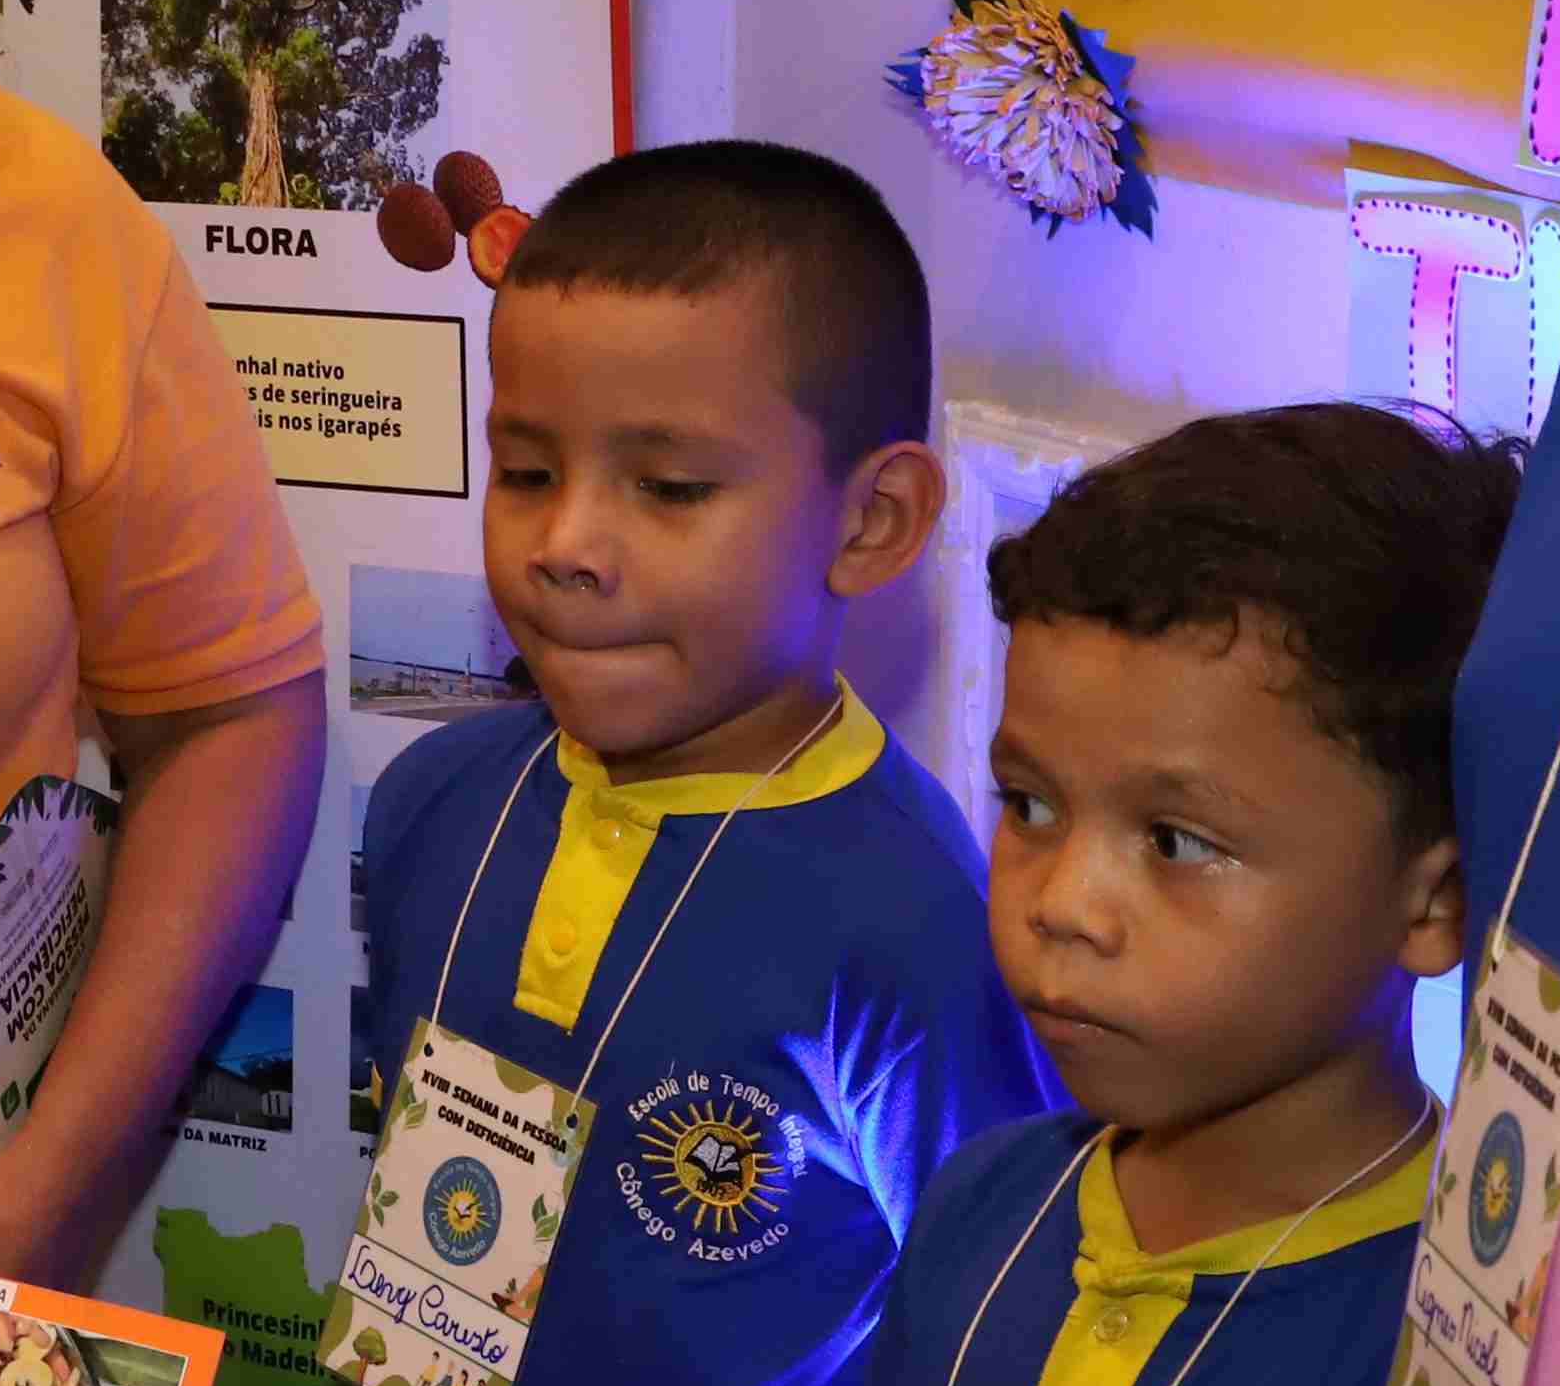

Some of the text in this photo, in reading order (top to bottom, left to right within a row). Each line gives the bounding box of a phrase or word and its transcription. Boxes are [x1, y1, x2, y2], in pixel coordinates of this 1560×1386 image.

[204, 224, 318, 259] FLORA
[282, 360, 345, 380] nativo
[262, 384, 403, 413] de seringueira
[279, 413, 403, 442] nos igarapés
[421, 1069, 567, 1154] XVIII SEMANA DA PESSOA
[628, 1076, 680, 1122] Escola
[687, 1070, 710, 1093] de
[720, 1073, 779, 1117] Tempo
[184, 1127, 267, 1153] DA MATRIZ
[438, 1105, 535, 1165] COM DEFICIÊNCIA
[616, 1162, 789, 1261] Cônego Azevedo
